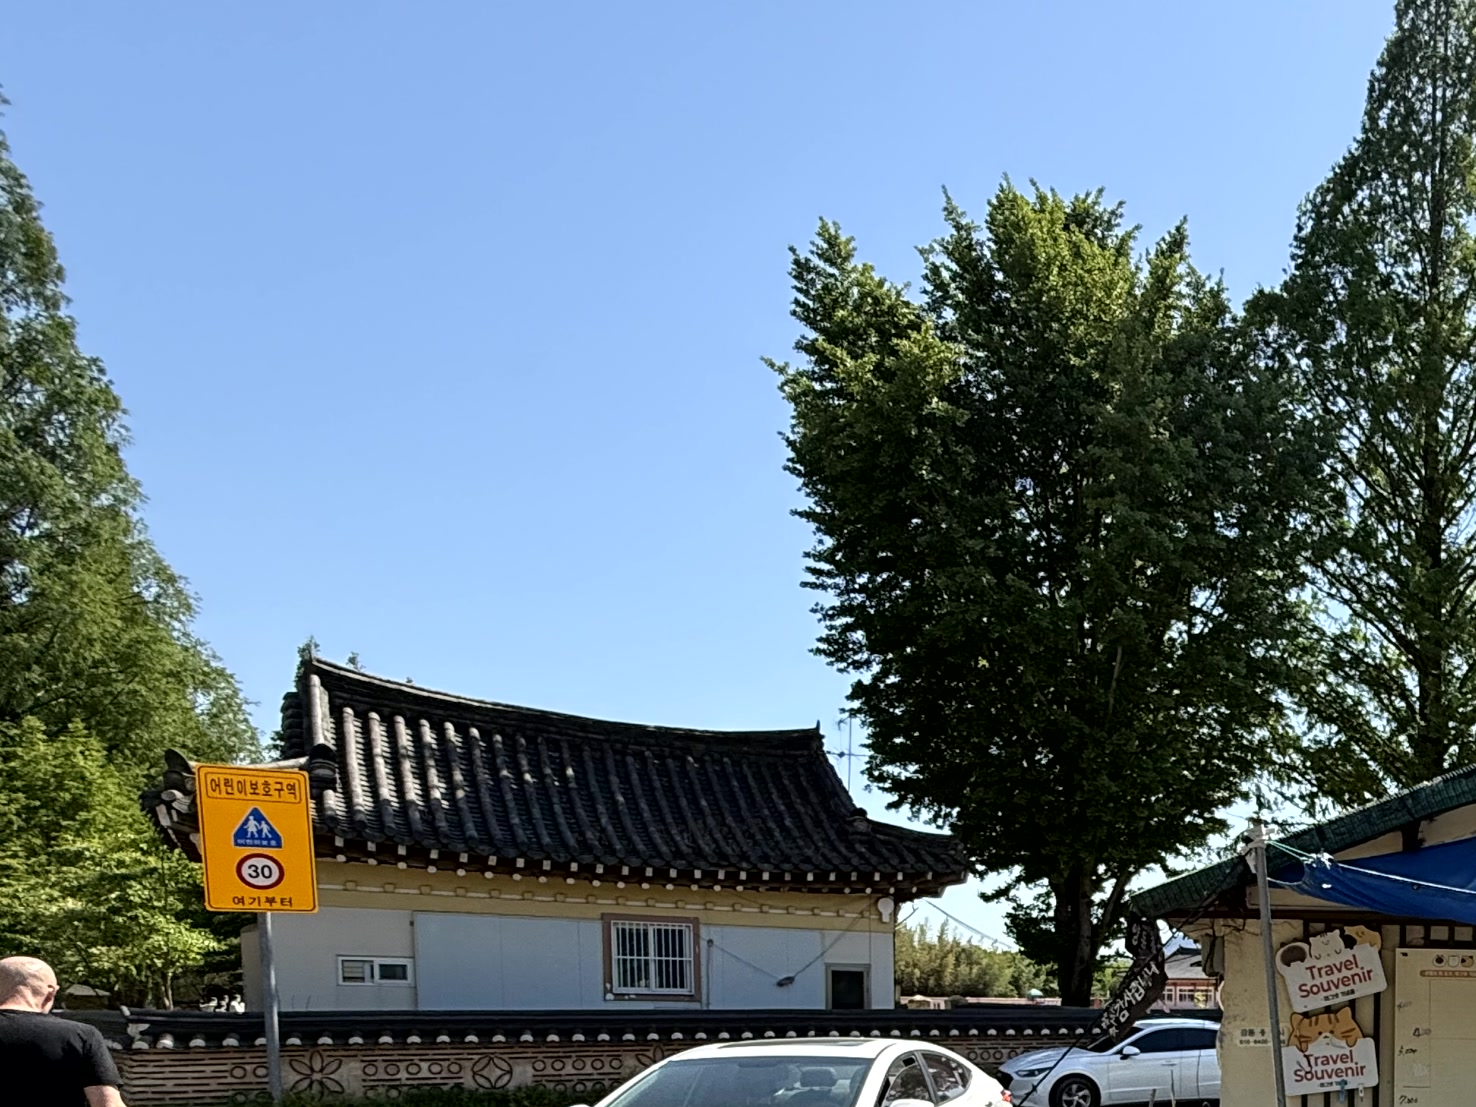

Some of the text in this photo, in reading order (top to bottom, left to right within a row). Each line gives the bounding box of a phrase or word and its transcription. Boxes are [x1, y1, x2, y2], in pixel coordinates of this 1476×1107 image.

[209, 776, 298, 801] 어린이보호구역
[247, 864, 273, 880] 30
[232, 895, 293, 908] 여기부터
[1304, 953, 1360, 981] Travel
[1297, 966, 1374, 999] Souvenir
[1303, 1049, 1355, 1067] Travel
[1293, 1061, 1367, 1083] Souvenir
